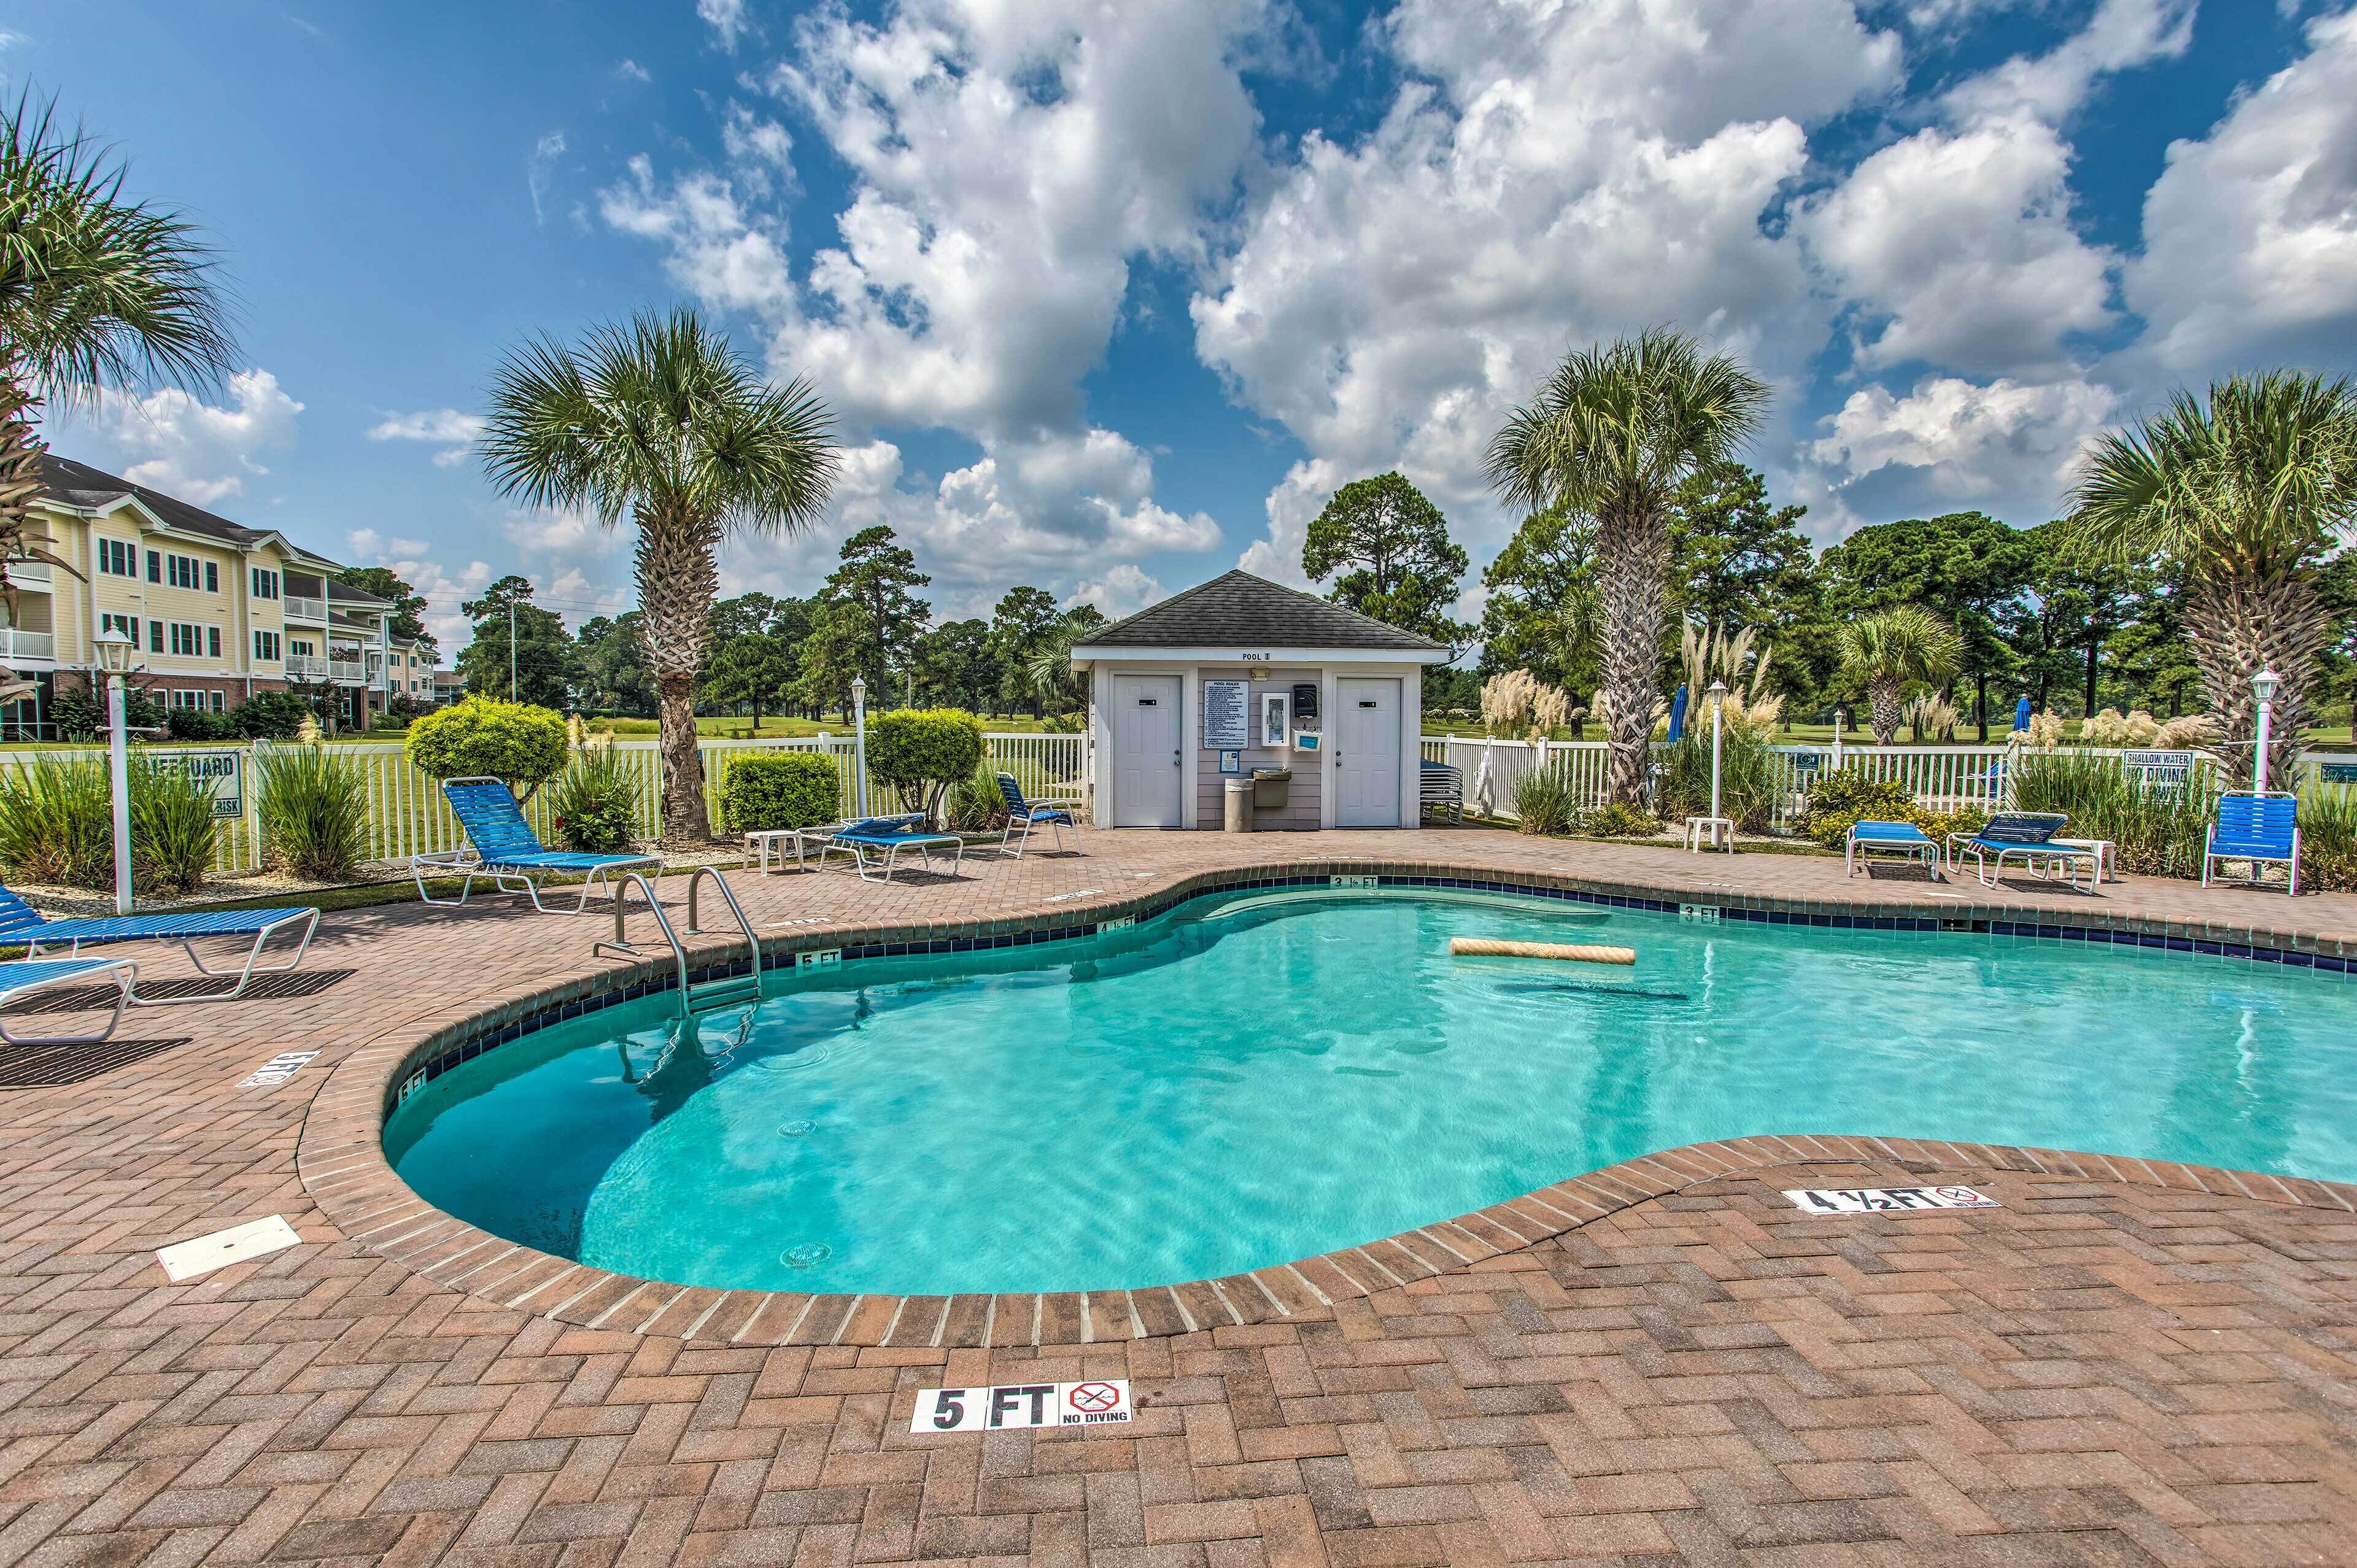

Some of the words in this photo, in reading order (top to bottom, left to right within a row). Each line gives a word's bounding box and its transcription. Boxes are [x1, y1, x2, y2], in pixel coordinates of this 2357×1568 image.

[2127, 754, 2161, 763] SHALLOW
[2163, 755, 2189, 764] WATER
[1363, 877, 1377, 887] FT
[1701, 907, 1718, 917] FT
[820, 951, 839, 964] FT
[401, 1083, 409, 1101] 5
[412, 1070, 425, 1092] FT
[1805, 1191, 1840, 1210] 4
[1879, 1189, 1943, 1208] FT
[934, 1390, 965, 1429] 5
[989, 1385, 1055, 1427] FT
[1063, 1414, 1081, 1424] NO
[1085, 1412, 1128, 1423] DIVING
